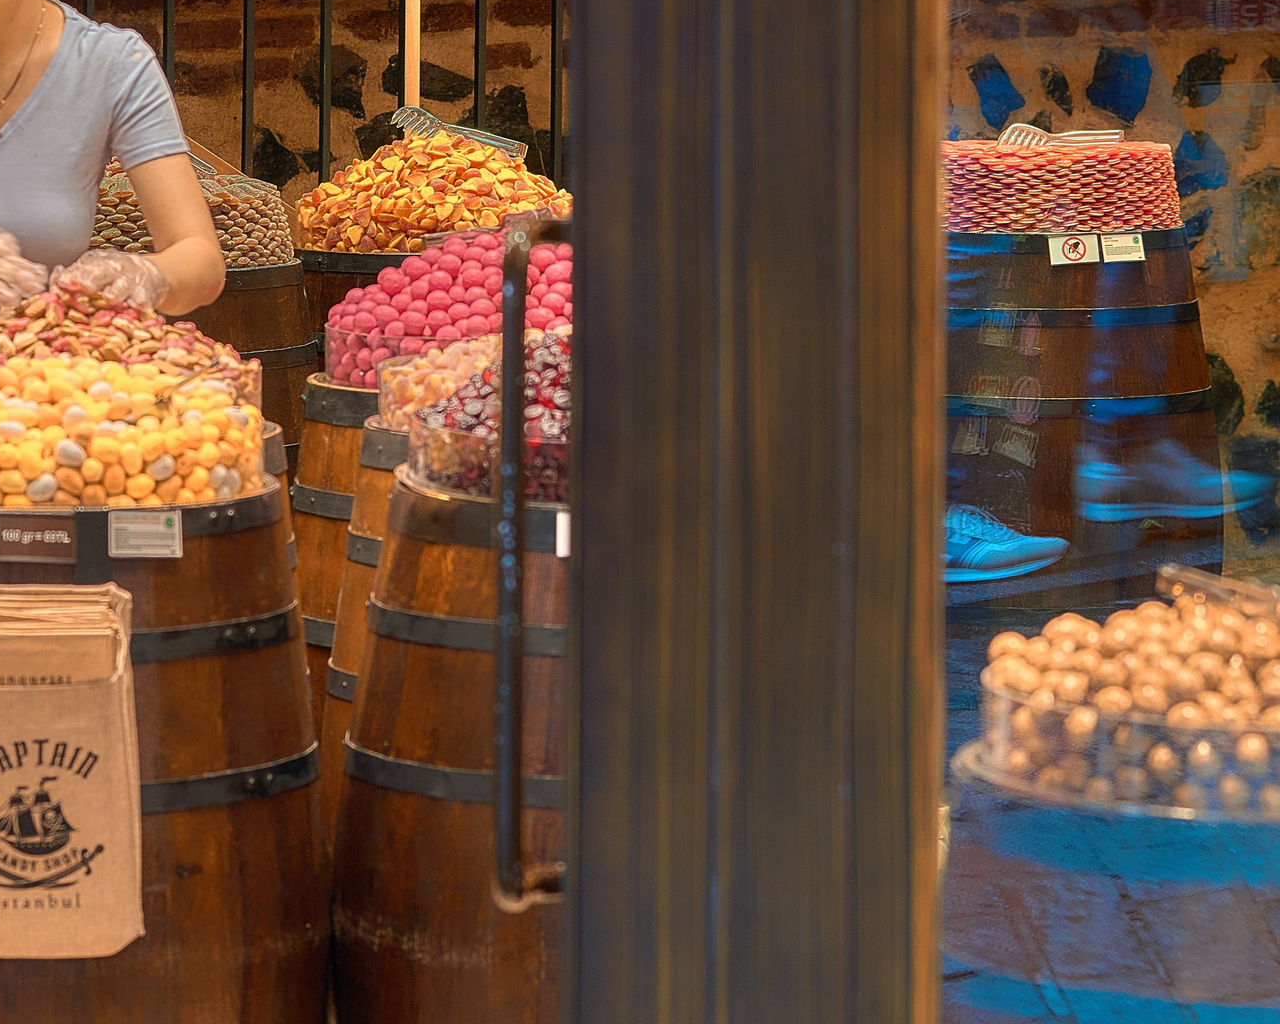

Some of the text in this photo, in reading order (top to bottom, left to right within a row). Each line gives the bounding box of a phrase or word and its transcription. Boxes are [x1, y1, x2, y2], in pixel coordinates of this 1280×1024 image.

[1, 528, 21, 542] 100
[43, 529, 71, 543] 69TL
[43, 847, 80, 871] SHOP
